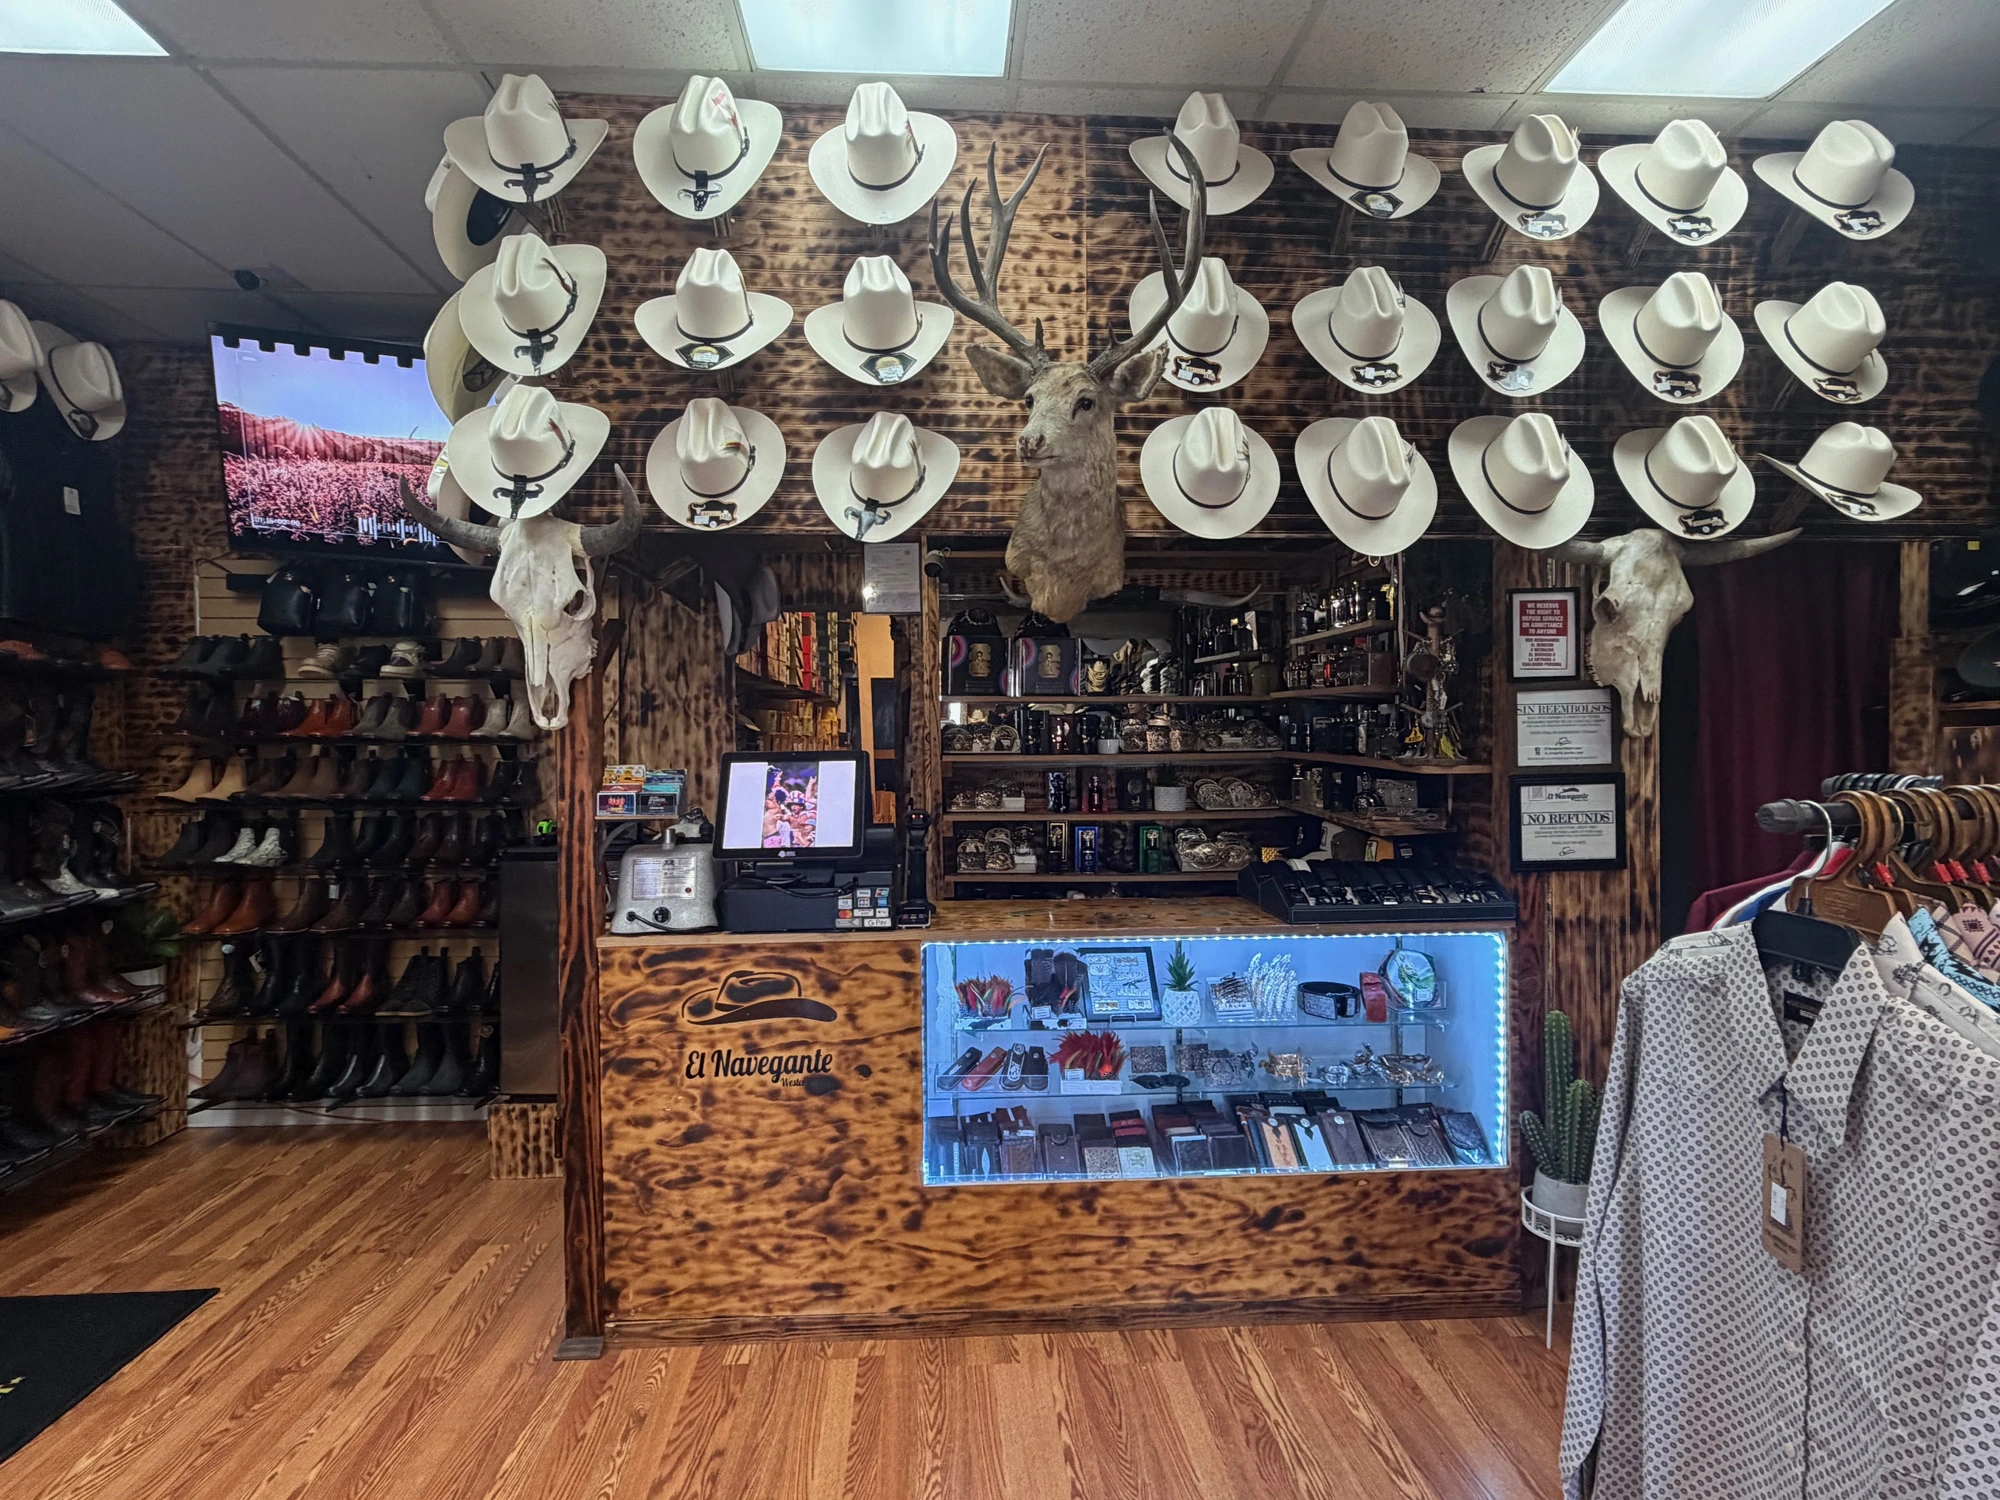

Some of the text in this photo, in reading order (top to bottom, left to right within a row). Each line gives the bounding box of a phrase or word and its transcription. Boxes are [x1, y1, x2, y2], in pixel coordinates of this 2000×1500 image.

[1527, 813, 1610, 824] NO REFUNDS
[685, 1049, 833, 1083] El Navegante
